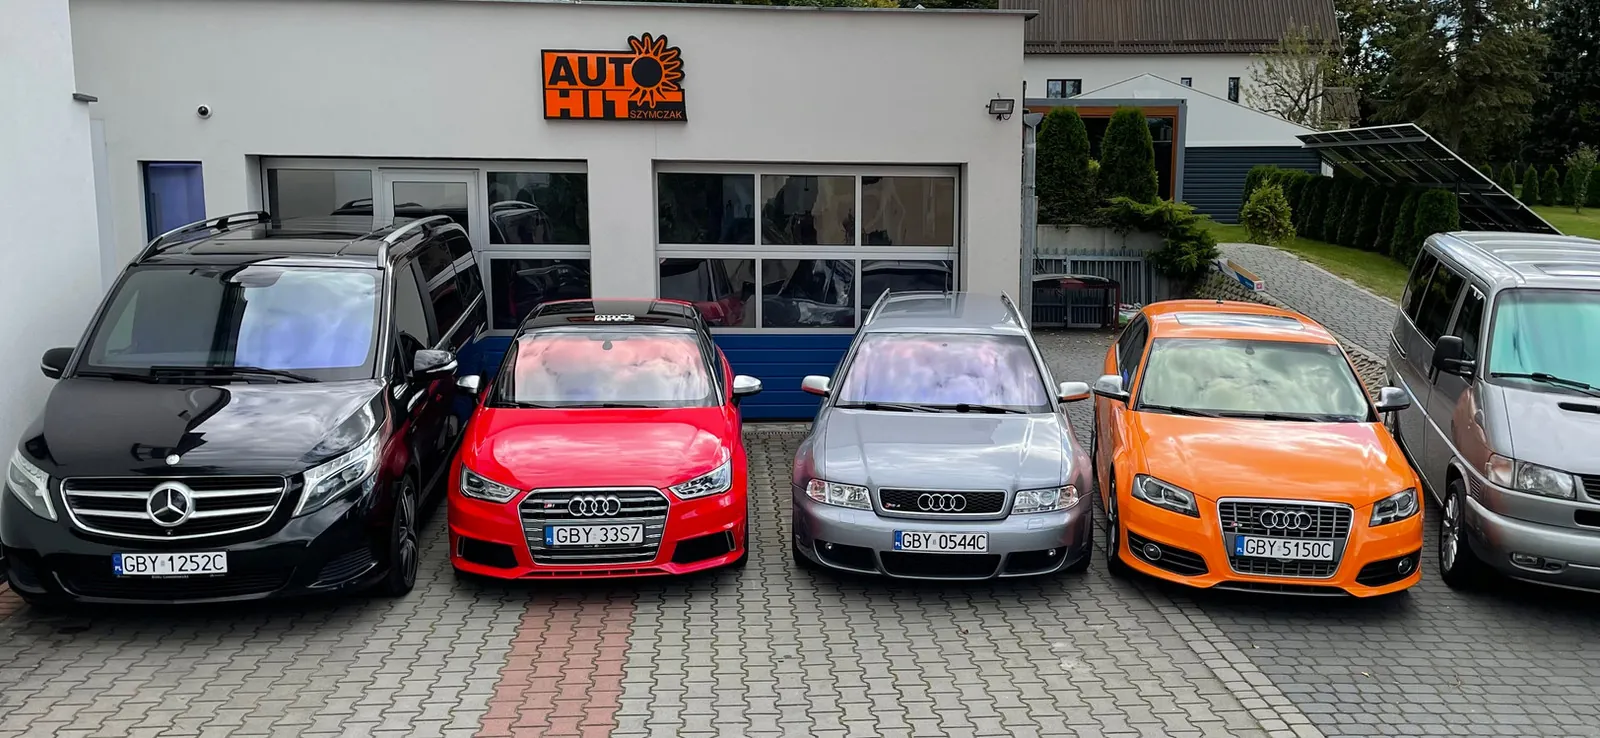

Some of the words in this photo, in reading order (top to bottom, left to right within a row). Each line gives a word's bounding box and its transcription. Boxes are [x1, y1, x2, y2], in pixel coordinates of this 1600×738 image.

[548, 55, 663, 88] AUTO
[546, 90, 629, 118] HIT
[629, 109, 683, 119] SZYMCZAK
[556, 527, 593, 544] GBY
[902, 532, 932, 549] GBY
[938, 534, 986, 550] 0544C
[1245, 538, 1277, 556] GBY
[1282, 540, 1331, 559] 5150C
[124, 555, 159, 573] GBY
[167, 554, 225, 572] 1252C
